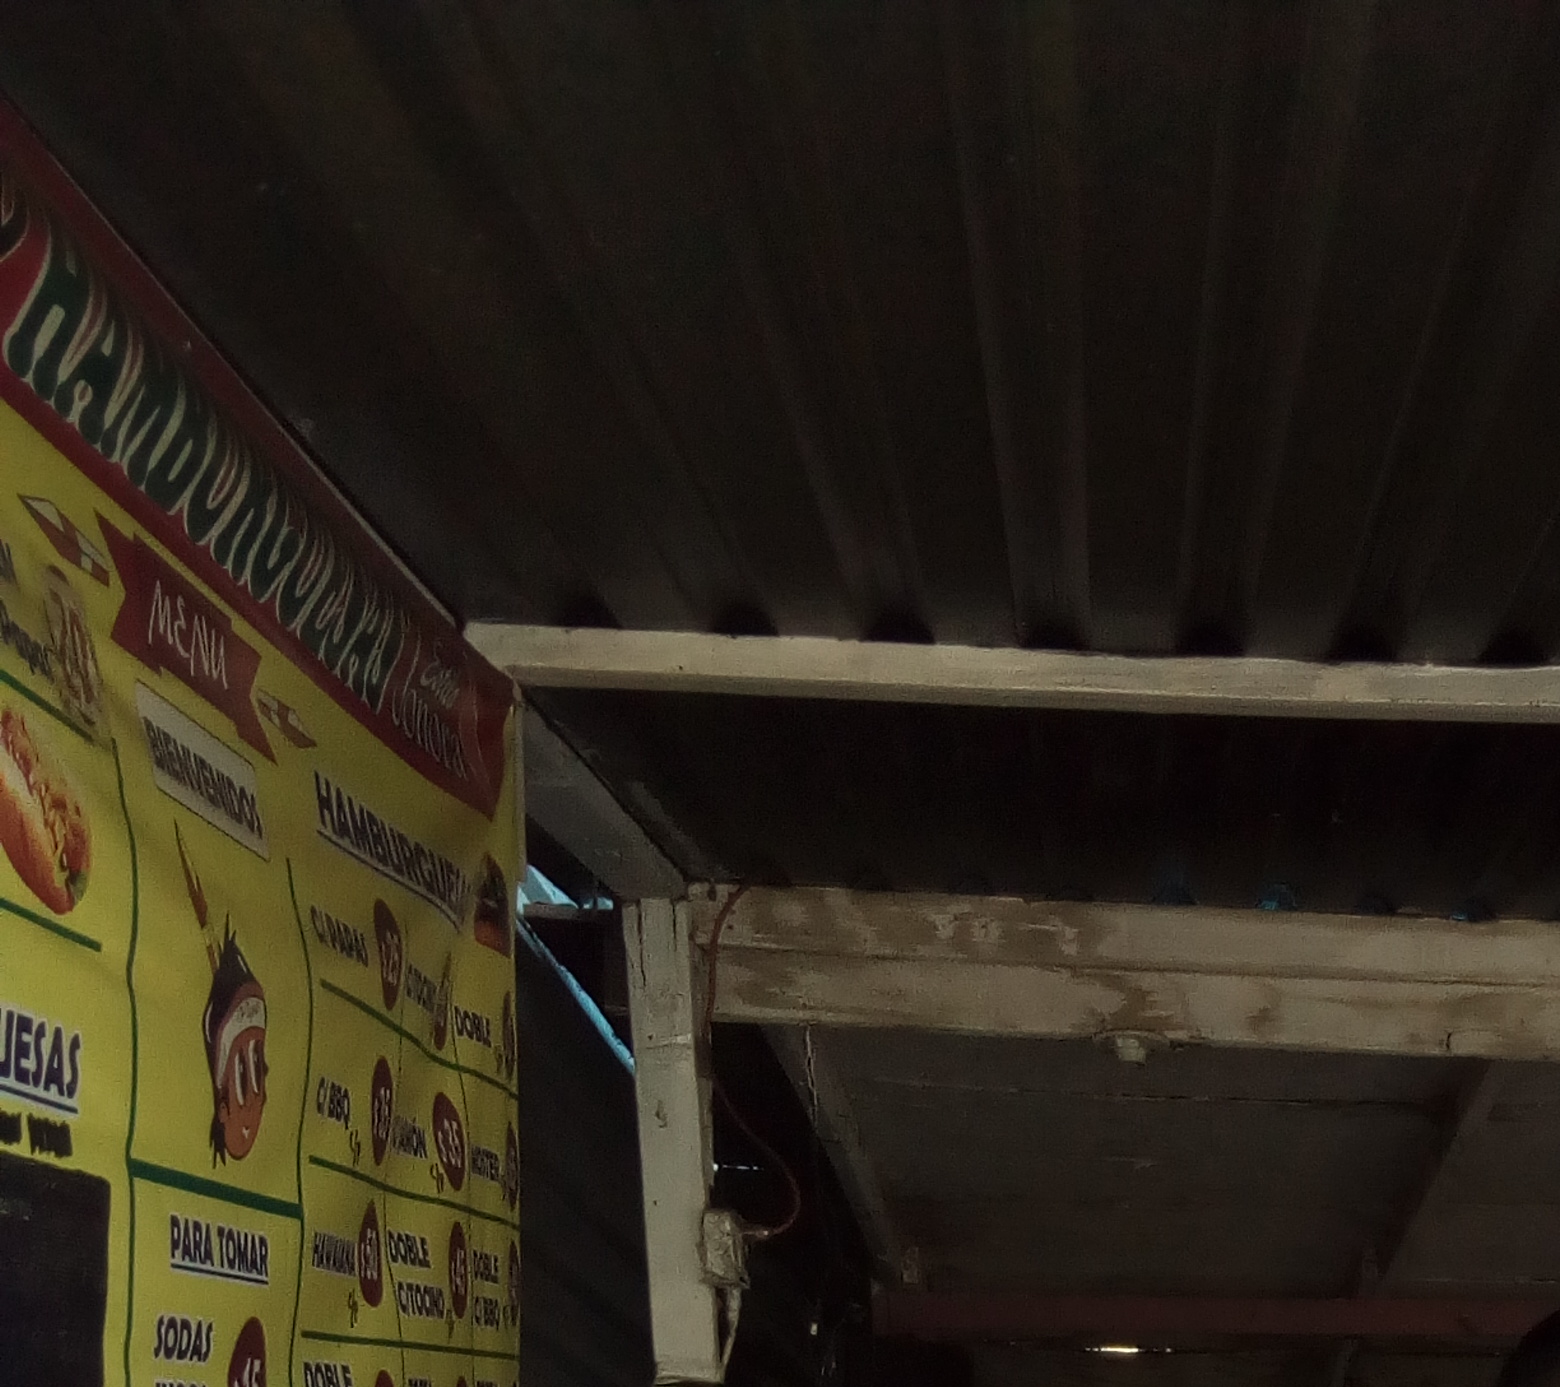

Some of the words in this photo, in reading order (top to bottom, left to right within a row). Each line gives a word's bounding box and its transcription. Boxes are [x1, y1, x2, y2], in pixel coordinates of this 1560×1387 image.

[148, 579, 228, 690] MENU
[454, 1006, 492, 1048] DOBLE
[170, 1214, 214, 1268] PARA
[217, 1224, 268, 1278] TOMAR
[387, 1230, 431, 1270] DOBLE
[154, 1315, 214, 1363] SODAS
